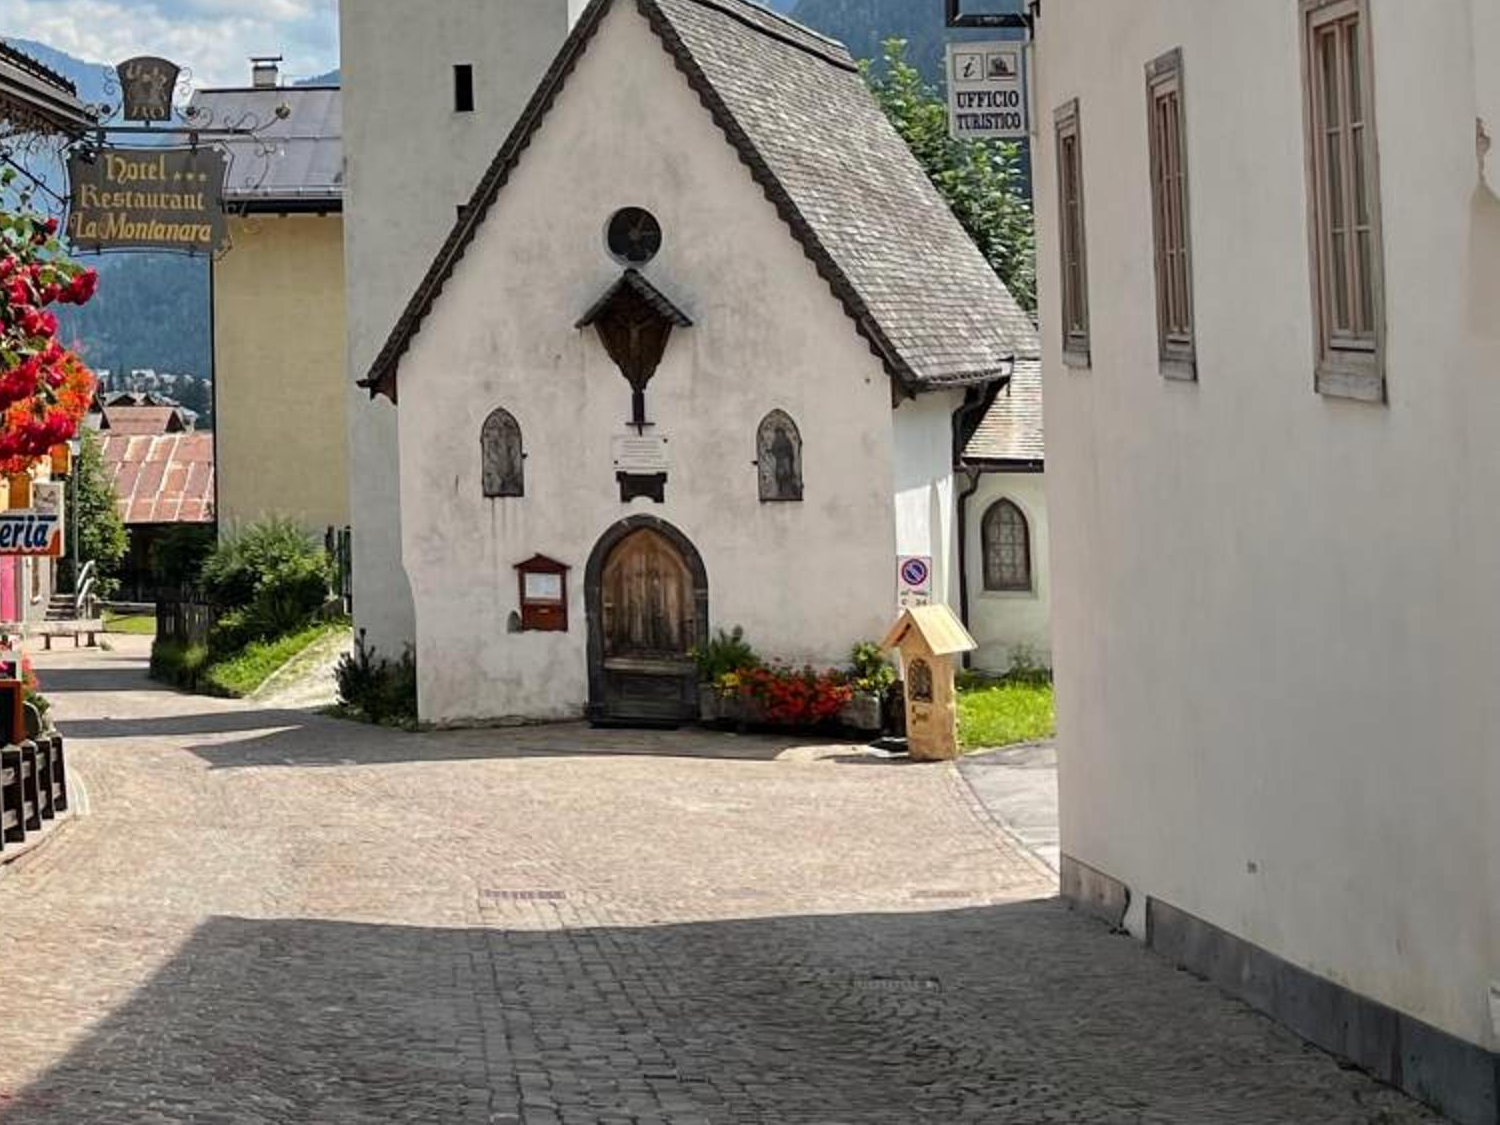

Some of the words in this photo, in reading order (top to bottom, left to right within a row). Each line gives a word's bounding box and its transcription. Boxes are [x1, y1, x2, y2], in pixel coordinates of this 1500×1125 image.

[956, 90, 1019, 108] UFFICIO
[956, 112, 1021, 130] TURISTICO
[105, 154, 166, 184] Hotel
[81, 184, 205, 211] Restaurant
[69, 212, 98, 239] La
[99, 212, 212, 242] Montanara
